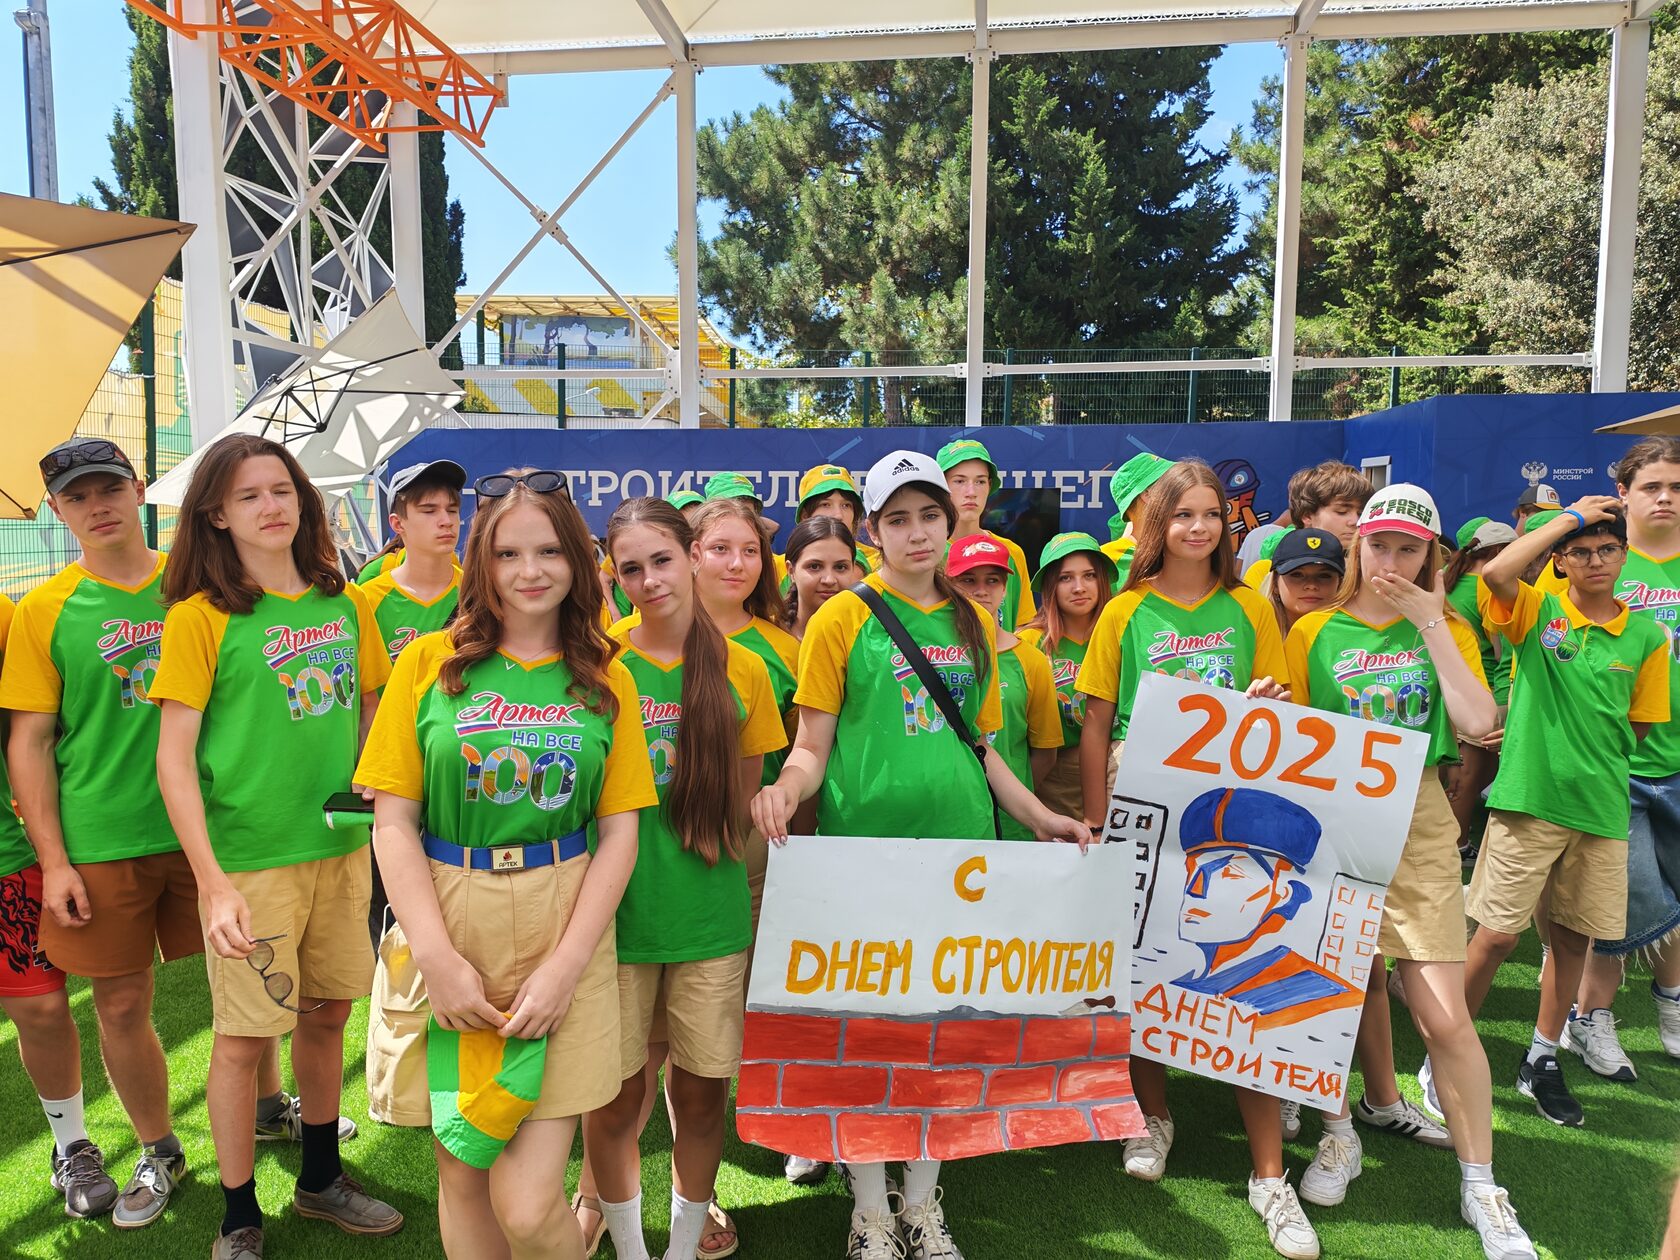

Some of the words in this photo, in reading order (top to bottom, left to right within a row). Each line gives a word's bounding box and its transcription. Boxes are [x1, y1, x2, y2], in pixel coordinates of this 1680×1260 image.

[892, 466, 920, 476] adidas
[1552, 467, 1594, 475] МИНСТРОЙ
[553, 469, 800, 508] ТРОИЛ
[1386, 506, 1432, 526] FRESH
[1388, 498, 1433, 518] BOSCO
[1615, 581, 1680, 608] Арт
[1655, 608, 1677, 620] НА
[97, 619, 164, 649] Арт
[263, 616, 346, 657] Артек
[1147, 627, 1236, 656] Артек
[146, 645, 161, 657] Н
[307, 650, 330, 665] НА
[332, 647, 354, 661] ВСЕ
[891, 641, 971, 667] тек
[1185, 656, 1205, 668] НА
[1207, 654, 1235, 666] ВСЕ
[1332, 645, 1429, 672] Артек
[112, 658, 161, 708] 10
[278, 662, 356, 721] 100
[949, 672, 975, 686] ВСЕ
[1376, 672, 1398, 684] НА
[1401, 670, 1429, 682] ВСЕ
[456, 690, 586, 729] Артек
[639, 695, 682, 726] Арт
[1342, 683, 1430, 726] 100
[511, 731, 540, 748] НА
[545, 732, 582, 752] ВСЕ
[1162, 693, 1403, 798] 2025
[460, 742, 577, 812] 100
[953, 855, 988, 903] С
[932, 935, 1115, 996] СТРОИТЕЛЯ
[1134, 983, 1260, 1045] ДНЁМ
[1141, 1026, 1342, 1100] СТРОИТЕЛЯ
